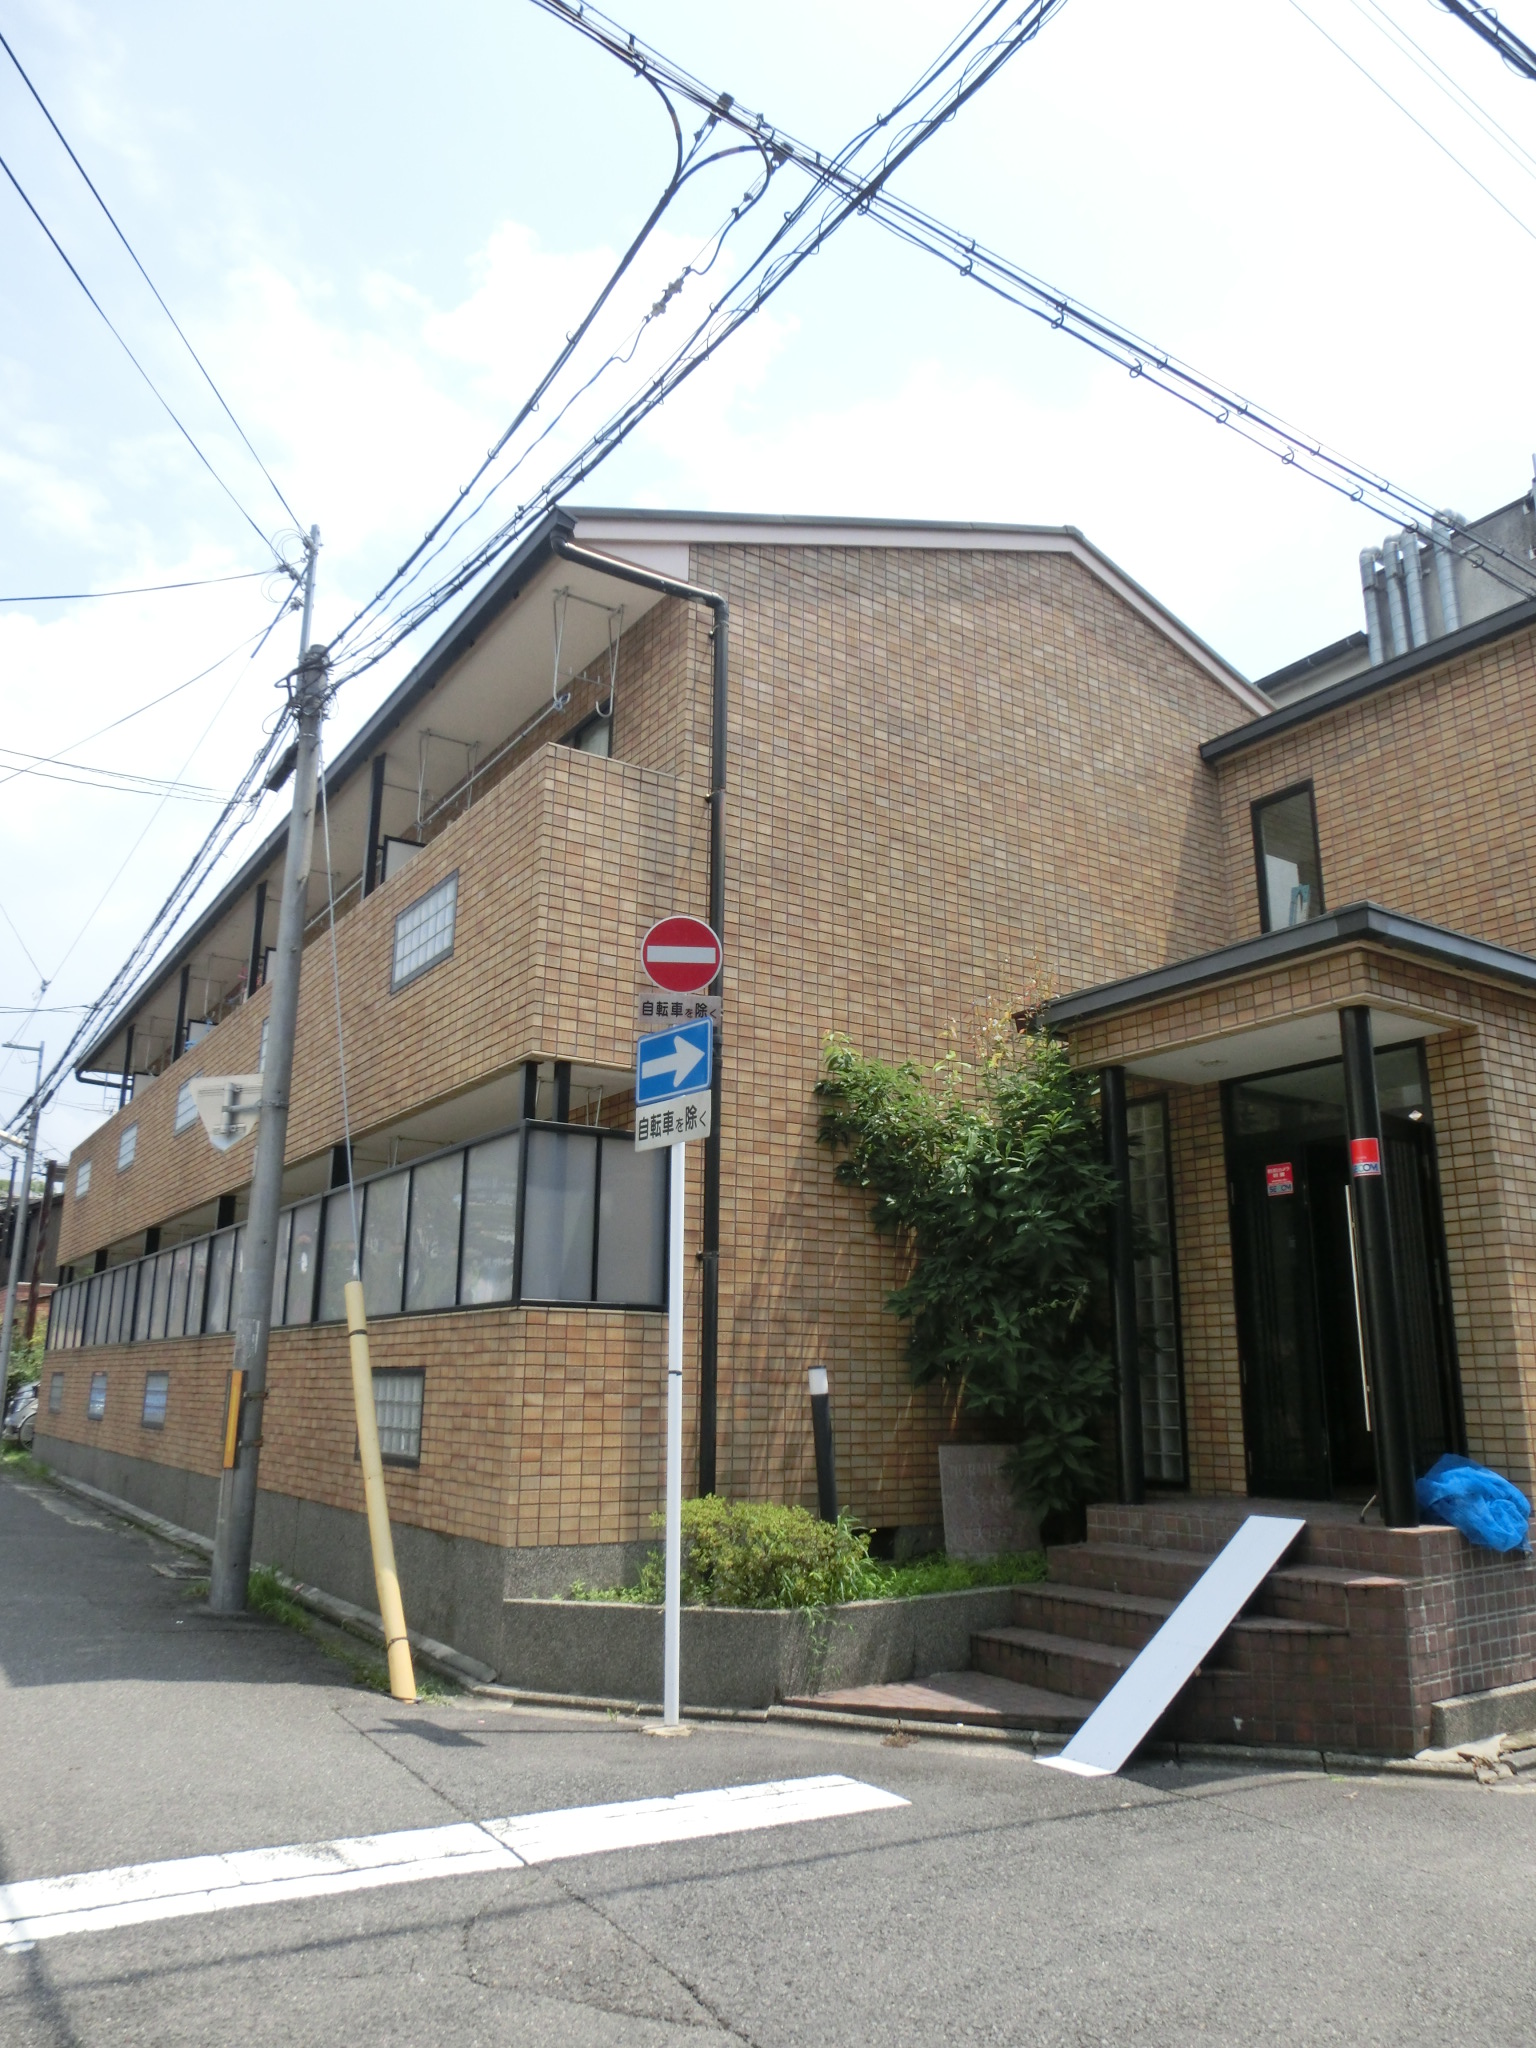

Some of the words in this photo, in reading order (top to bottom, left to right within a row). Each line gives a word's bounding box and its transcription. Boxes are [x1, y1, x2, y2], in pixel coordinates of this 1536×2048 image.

[642, 1001, 717, 1018] 自転車を除く
[638, 1104, 707, 1141] 自転車を除く
[1352, 1163, 1379, 1173] ECOM
